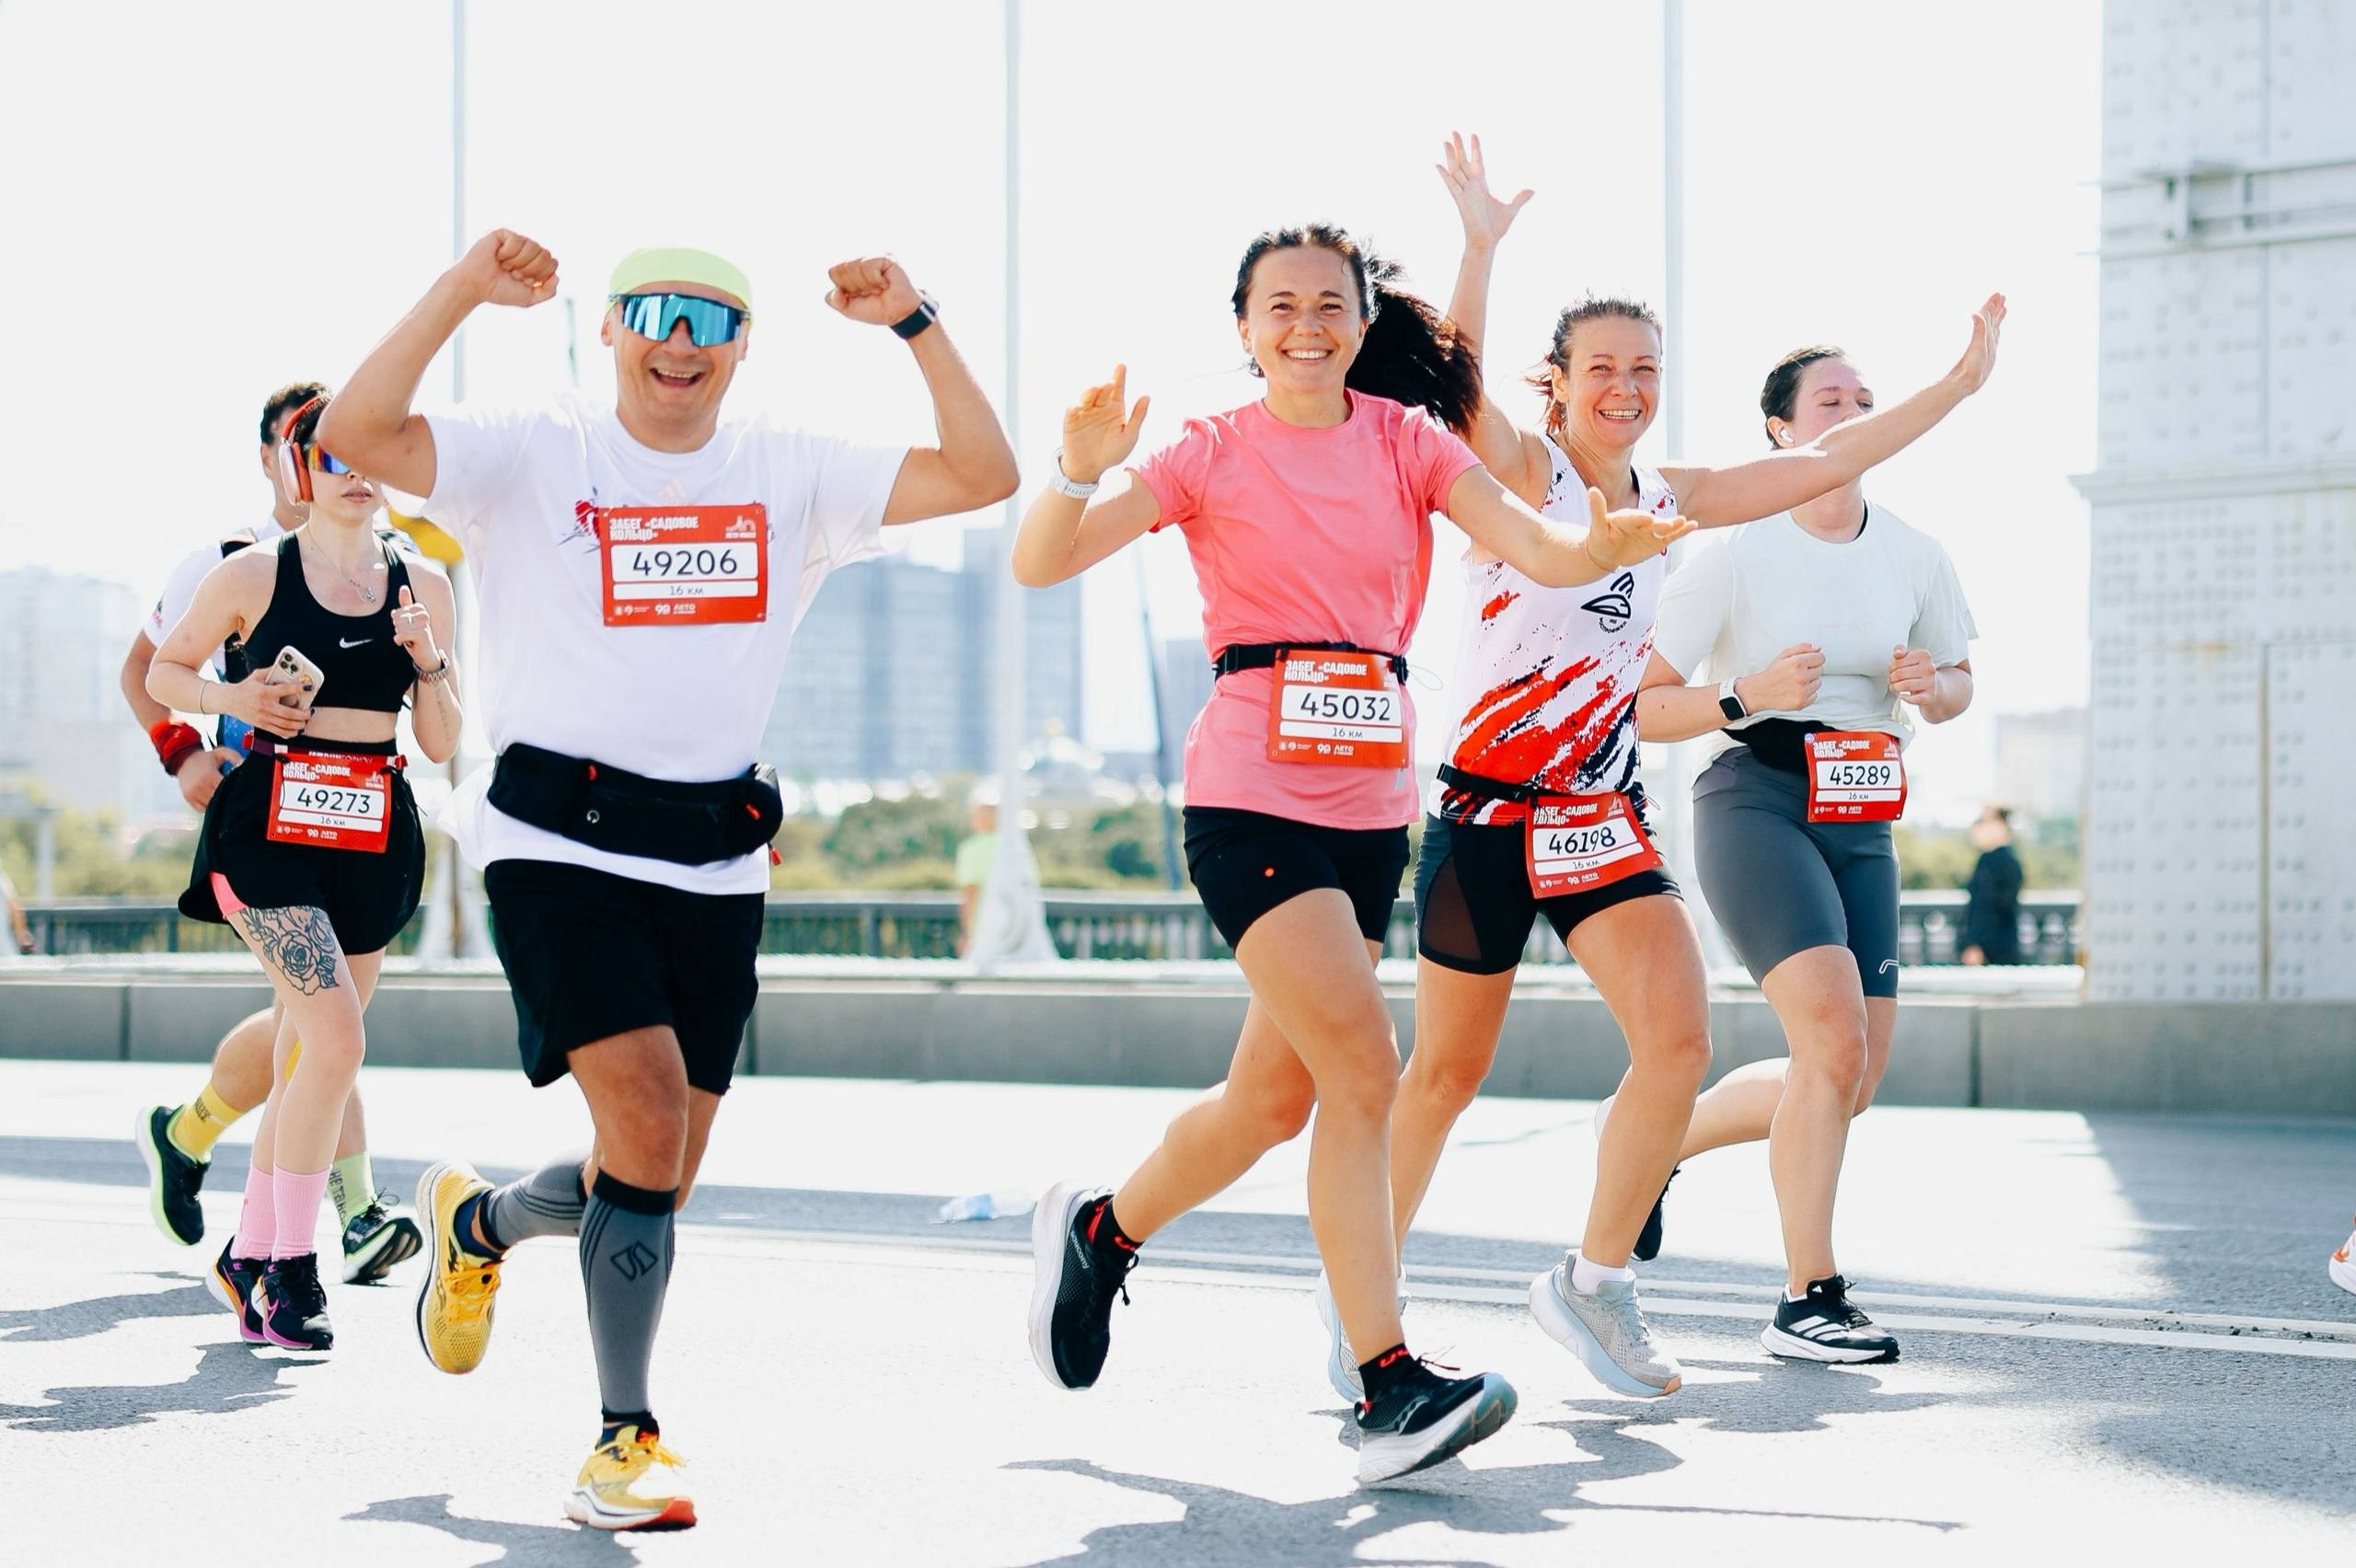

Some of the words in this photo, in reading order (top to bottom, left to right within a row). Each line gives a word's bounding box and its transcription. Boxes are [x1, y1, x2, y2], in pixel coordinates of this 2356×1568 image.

[632, 548, 738, 577] 49206
[669, 585, 684, 597] 16
[1286, 660, 1316, 672] ЗАБЕГ
[1318, 662, 1369, 676] «САДОВОЕ
[1299, 692, 1391, 721] 45032
[1333, 727, 1345, 737] 16
[1830, 766, 1890, 785] 45289
[296, 787, 371, 813] 49273
[1848, 792, 1857, 801] 16
[320, 816, 331, 824] 16
[1548, 826, 1616, 855] 46198
[1573, 860, 1585, 870] 16
